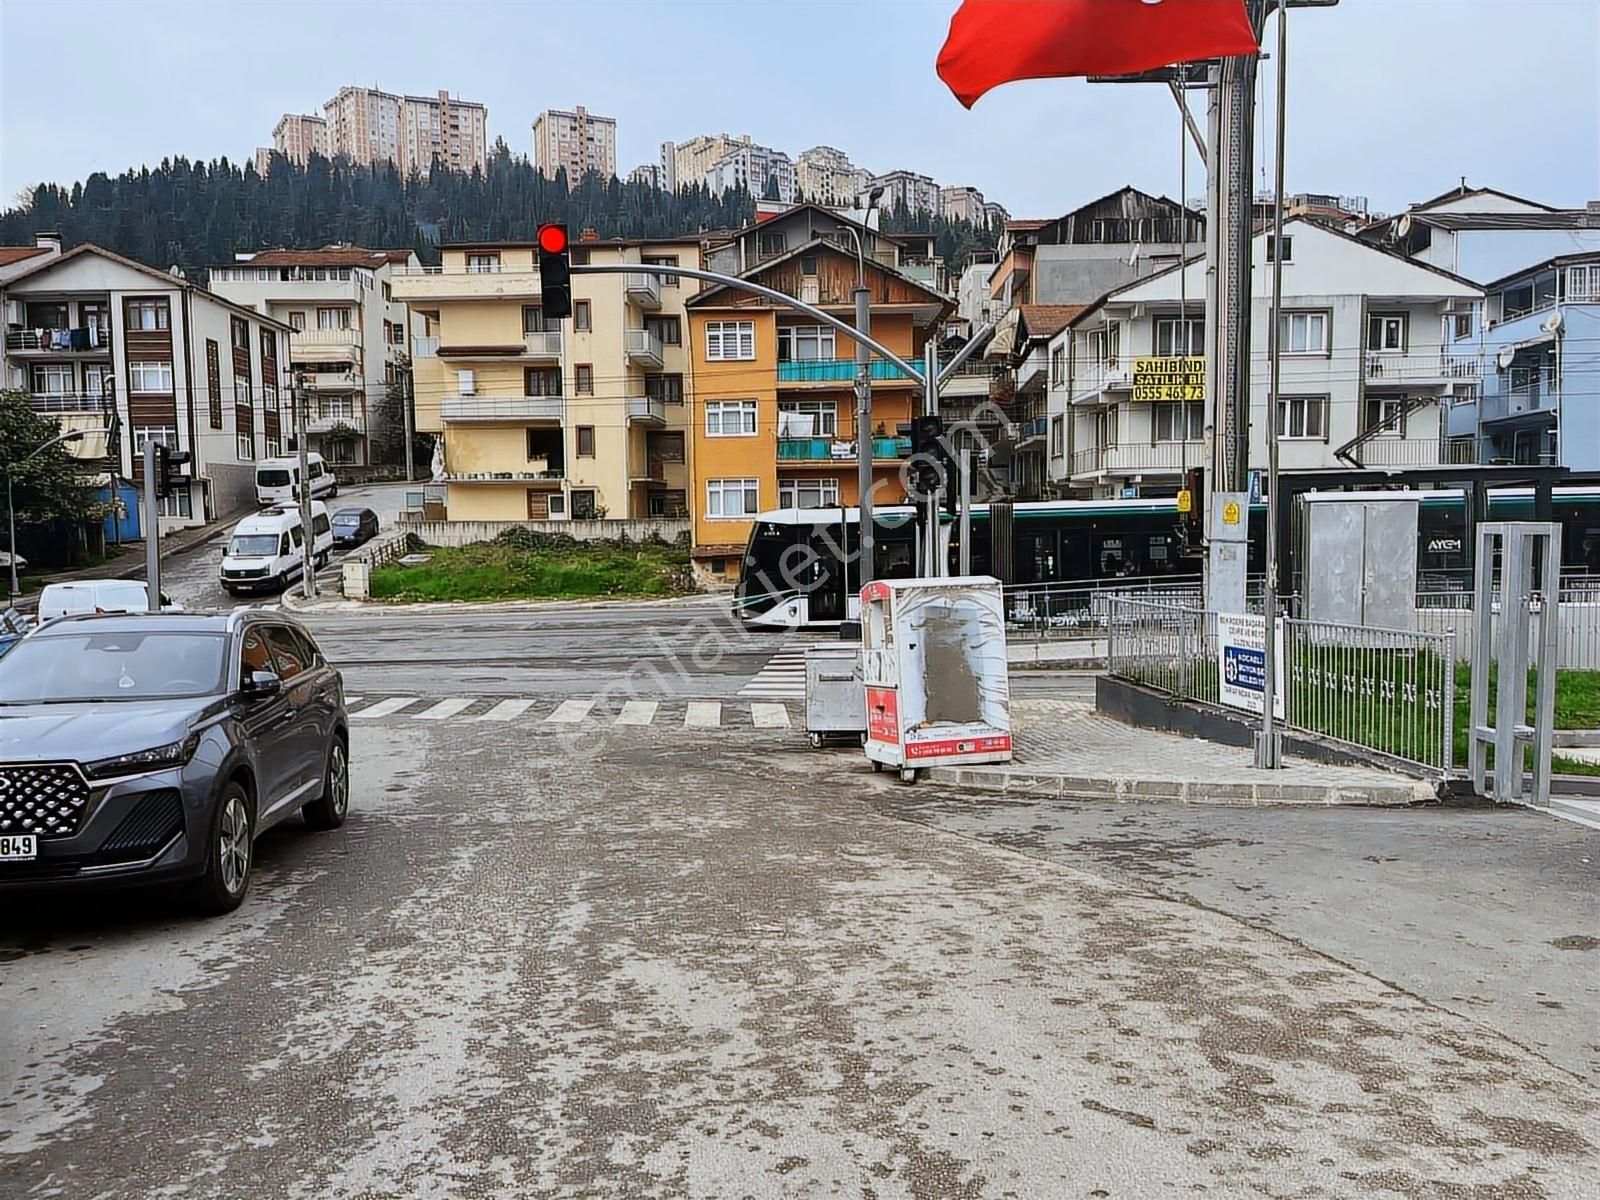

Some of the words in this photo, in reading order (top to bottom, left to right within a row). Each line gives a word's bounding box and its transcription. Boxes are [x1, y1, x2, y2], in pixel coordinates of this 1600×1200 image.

[1135, 386, 1162, 399] 0555
[1190, 386, 1204, 399] 73
[0, 838, 32, 855] 849
